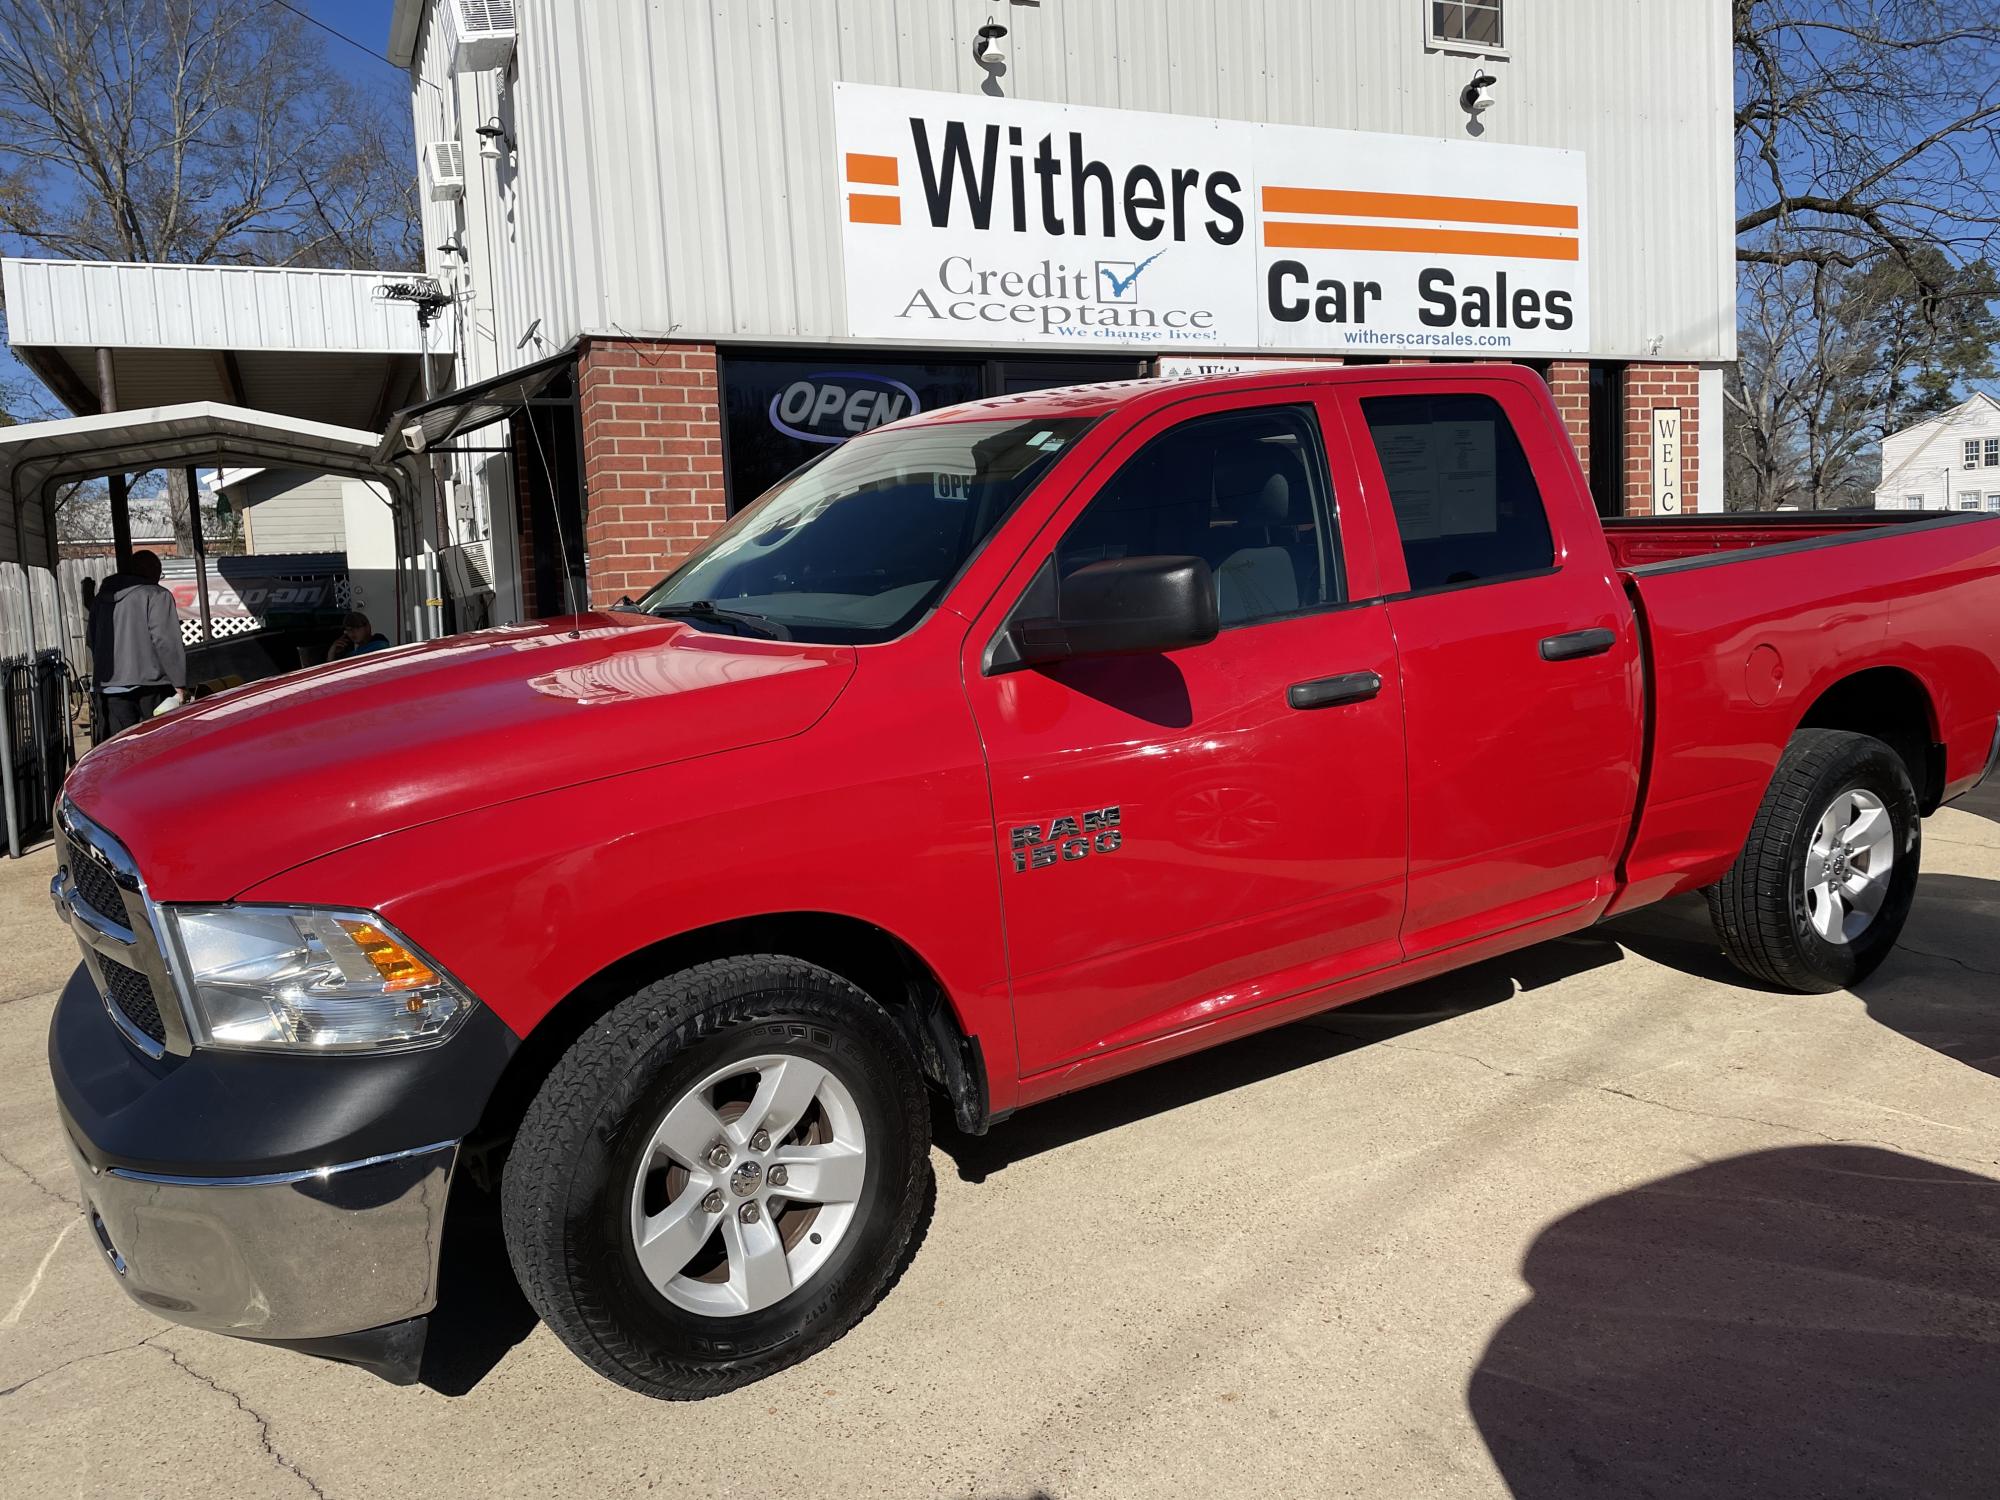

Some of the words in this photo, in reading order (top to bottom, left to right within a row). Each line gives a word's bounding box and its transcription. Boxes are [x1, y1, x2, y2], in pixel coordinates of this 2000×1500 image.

[909, 116, 1244, 246] Withers
[938, 255, 1090, 301] Credit
[1267, 259, 1382, 324] Car
[1417, 267, 1574, 331] Sales
[895, 288, 1214, 335] Acceptance
[1057, 326, 1088, 337] We
[1094, 327, 1162, 342] change
[1169, 329, 1218, 341] lives!
[1344, 329, 1511, 347] witherscarsales.com
[780, 381, 905, 432] OPEN
[1658, 419, 1676, 512] WELC
[1010, 805, 1121, 849] RAM
[1011, 830, 1122, 873] 1500
